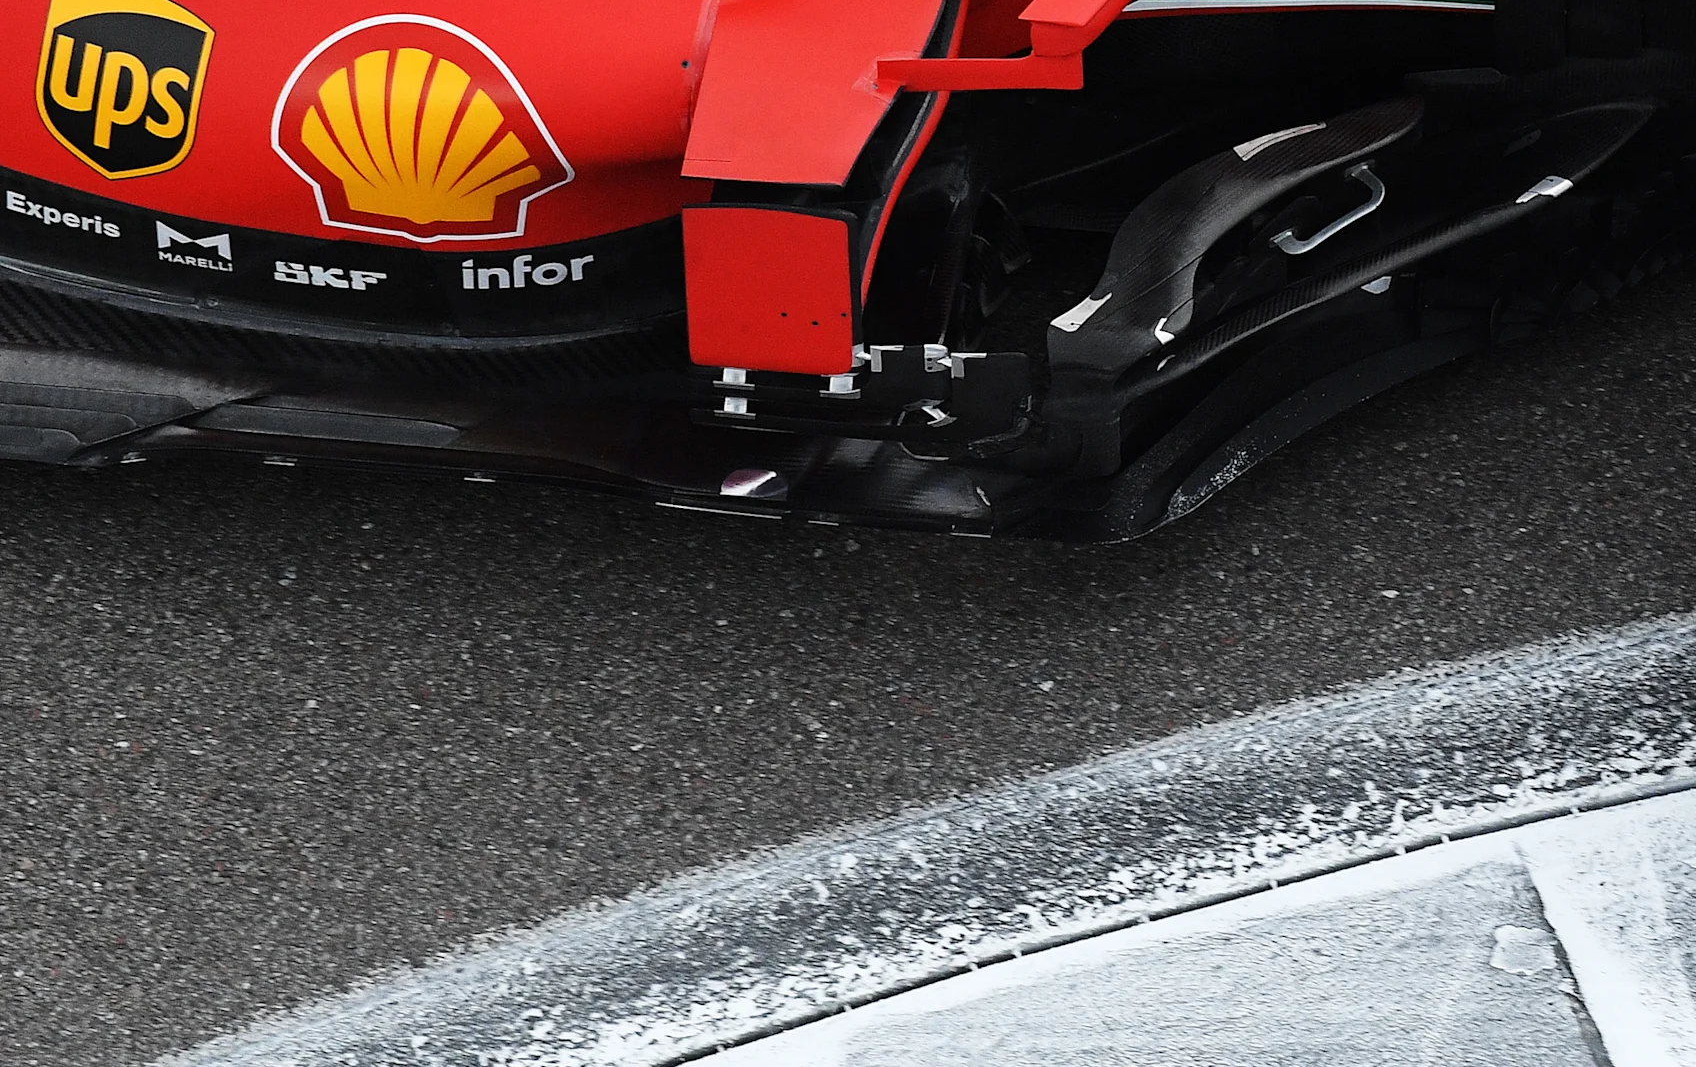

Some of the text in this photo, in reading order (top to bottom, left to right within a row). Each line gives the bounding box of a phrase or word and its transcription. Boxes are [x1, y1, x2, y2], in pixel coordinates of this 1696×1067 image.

[49, 34, 190, 149] ups
[6, 190, 121, 238] Experis
[158, 250, 233, 272] MARELLI
[273, 260, 388, 291] SKF
[461, 254, 594, 290] infor
